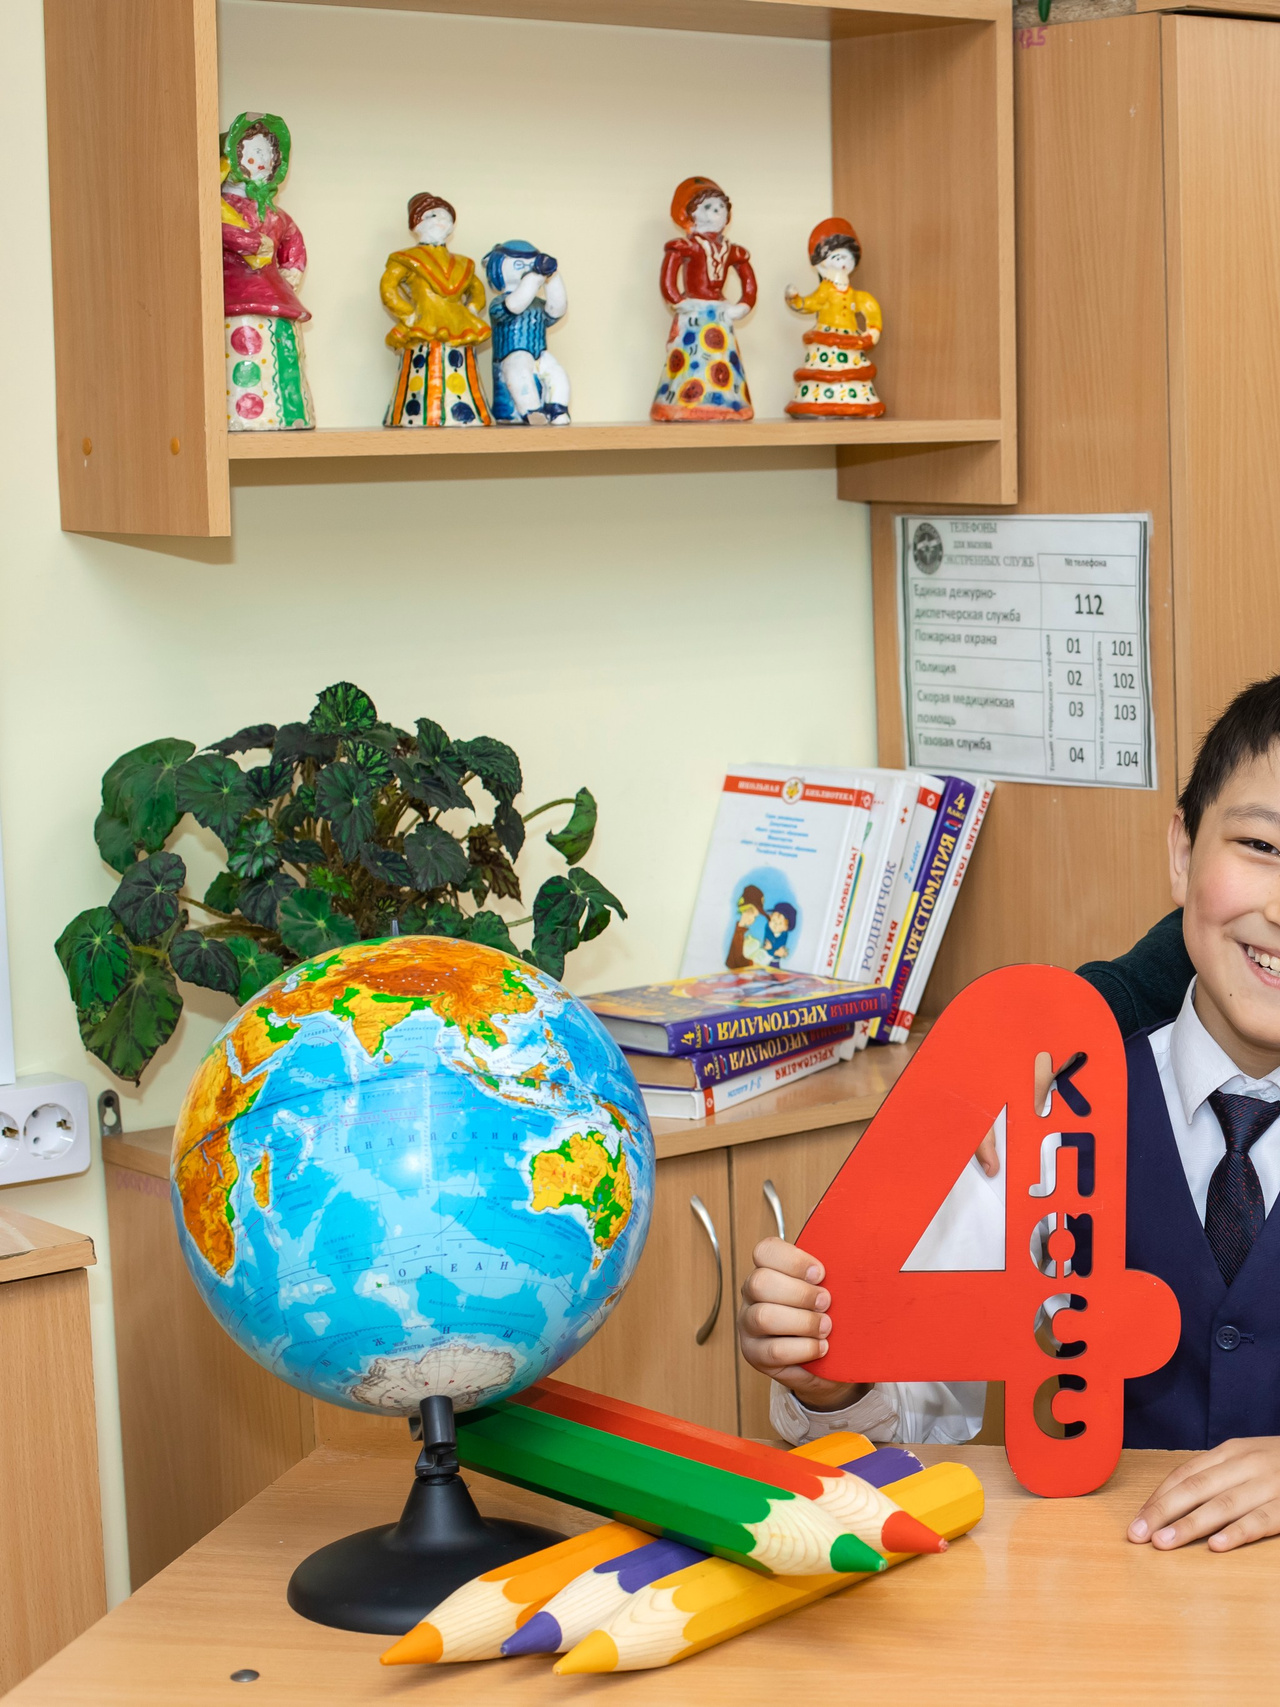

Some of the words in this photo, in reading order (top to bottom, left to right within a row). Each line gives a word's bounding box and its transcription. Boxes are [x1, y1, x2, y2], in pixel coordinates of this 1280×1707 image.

[950, 522, 997, 533] ТЕЛЕФОНЫ
[1003, 556, 1035, 568] СЛУЖБ
[1074, 558, 1107, 569] телефона
[914, 584, 947, 597] Единая
[949, 587, 997, 600] дежурно-
[1075, 593, 1104, 616] 112
[915, 608, 983, 622] диспетчерская
[986, 609, 1021, 624] служба
[915, 629, 961, 645] Пожарная
[964, 633, 997, 646] охрана
[1066, 638, 1081, 654] 01
[1111, 640, 1133, 657] 101
[915, 660, 956, 675] Полиция
[1067, 670, 1082, 686] 02
[1113, 672, 1135, 689] 102
[917, 690, 950, 705] Скорая
[953, 694, 1015, 708] медицинская
[1068, 701, 1084, 717] 03
[1114, 704, 1137, 721] 103
[917, 714, 957, 727] помощь
[918, 733, 955, 747] Газовая
[956, 737, 991, 751] служба
[1069, 747, 1084, 763] 04
[1116, 750, 1139, 767] 104
[805, 788, 854, 801] БИБЛИОТЕКА
[953, 792, 966, 811] 4
[965, 791, 990, 851] ВРЕМЕНА
[953, 856, 968, 887] ГОДА
[826, 933, 839, 968] БУДЬ
[835, 846, 859, 928] ЧЕЛОВЕКОМ!
[903, 833, 957, 967] ХРЕСТОМАТИЯ
[861, 860, 897, 971] РОДНИЧОК
[830, 998, 879, 1018] ПОЛНАЯ
[716, 1004, 828, 1041] ХРЕСТОМАТИЯ
[680, 1031, 695, 1046] 4
[729, 1032, 809, 1071] ХРЕСТОМАТИЯ
[703, 1063, 715, 1076] 3
[775, 1047, 835, 1081] ХРЕСТОМАТИЯ
[343, 1132, 518, 1154] ИНДИЙСКИЙ
[800, 963, 1182, 1498] 4
[398, 1261, 508, 1278] ОКЕАН
